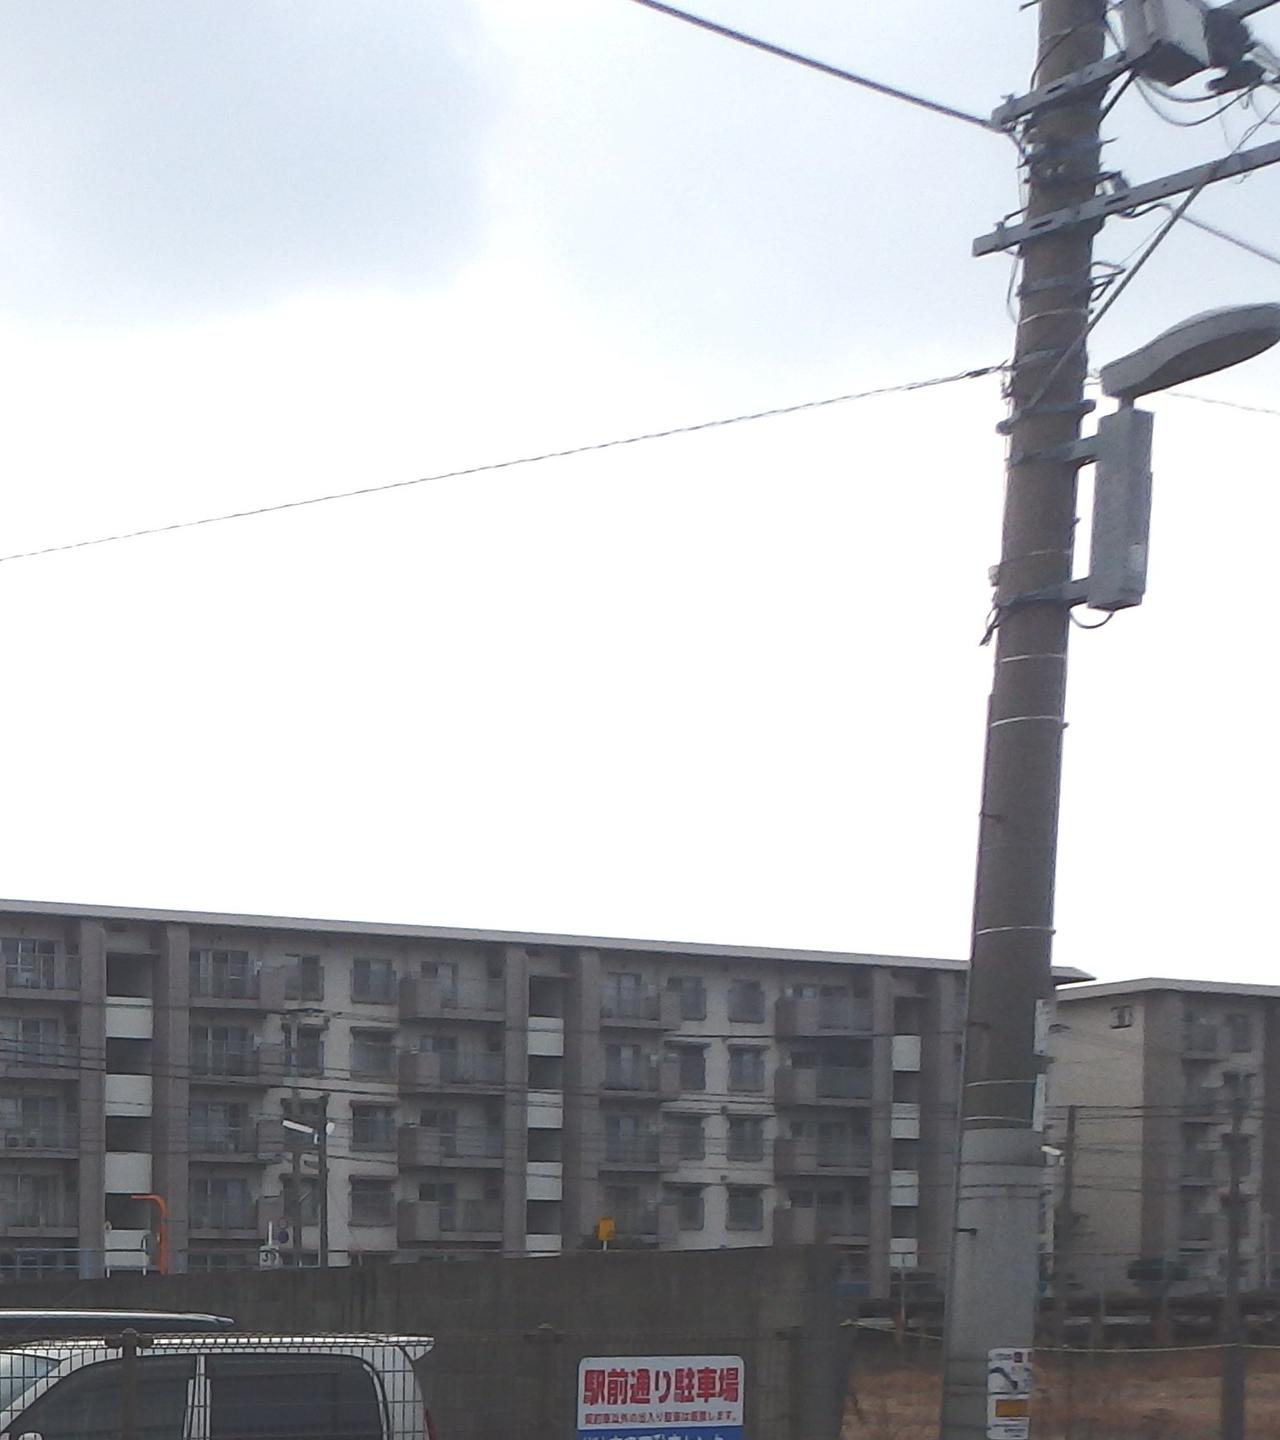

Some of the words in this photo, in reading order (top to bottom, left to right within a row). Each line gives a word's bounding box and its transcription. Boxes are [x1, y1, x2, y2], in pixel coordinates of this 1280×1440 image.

[583, 1366, 739, 1406] 駅前通り駐車場
